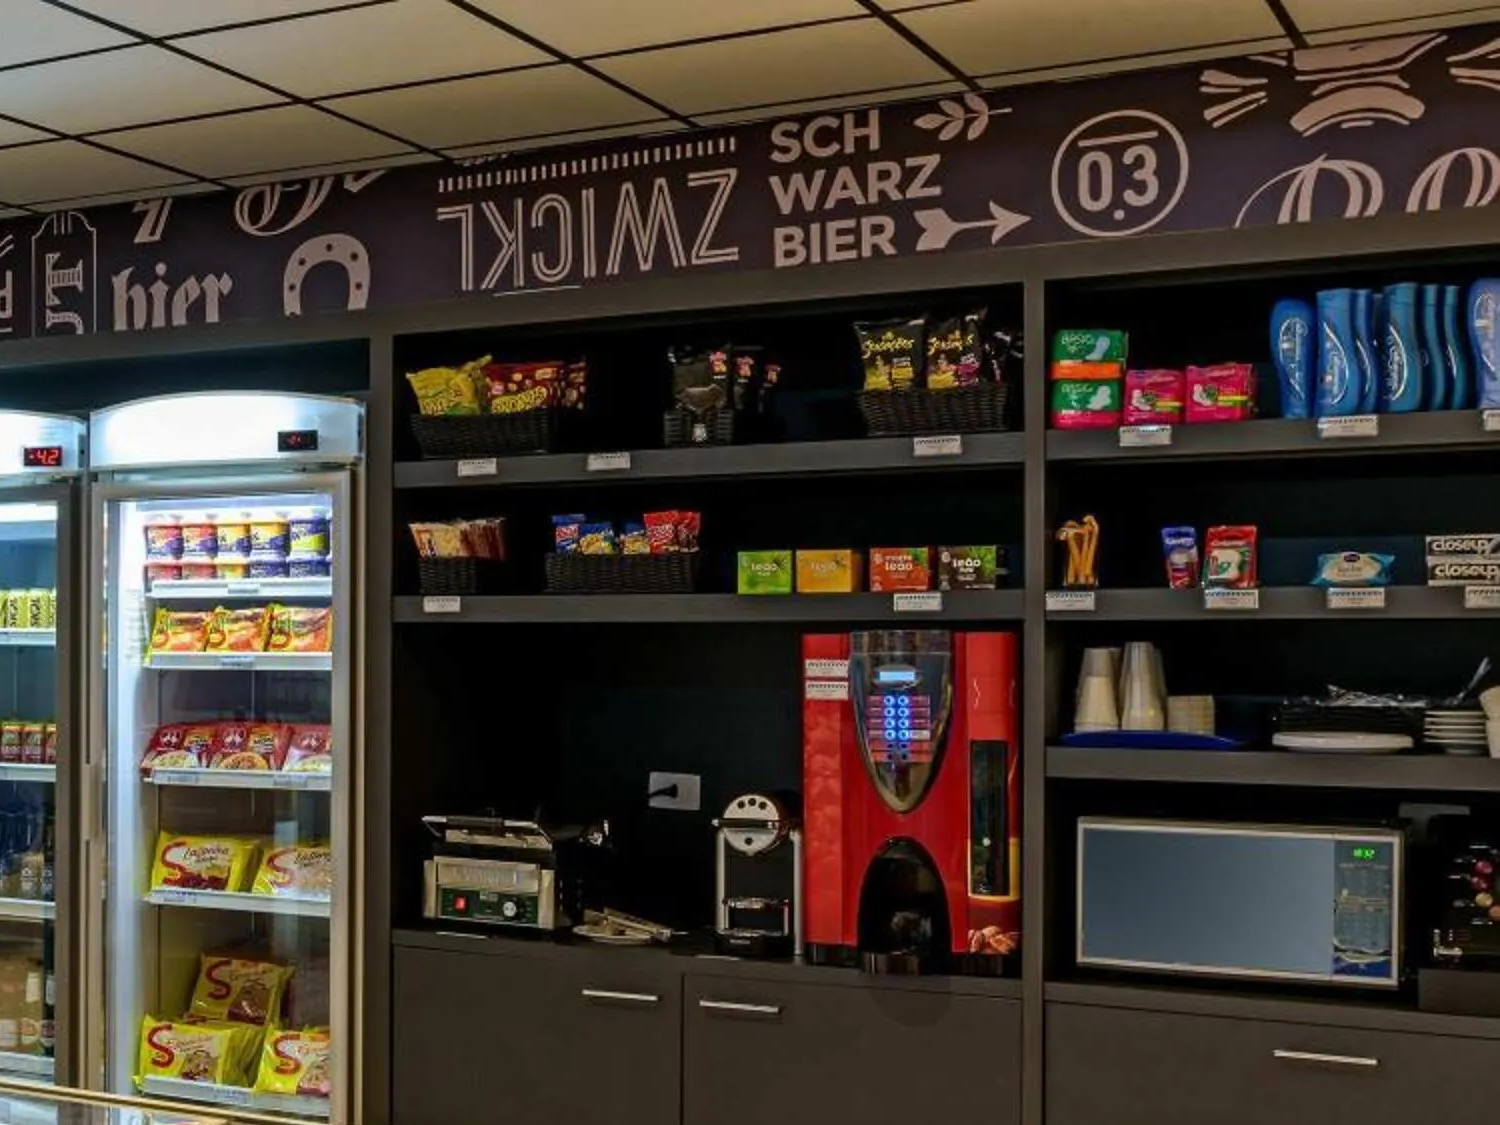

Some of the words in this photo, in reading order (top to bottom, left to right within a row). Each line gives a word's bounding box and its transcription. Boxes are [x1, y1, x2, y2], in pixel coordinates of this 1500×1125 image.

[770, 109, 880, 163] SCH
[769, 154, 942, 214] WARZ
[437, 168, 740, 291] ZWICKL
[774, 214, 898, 268] BIER
